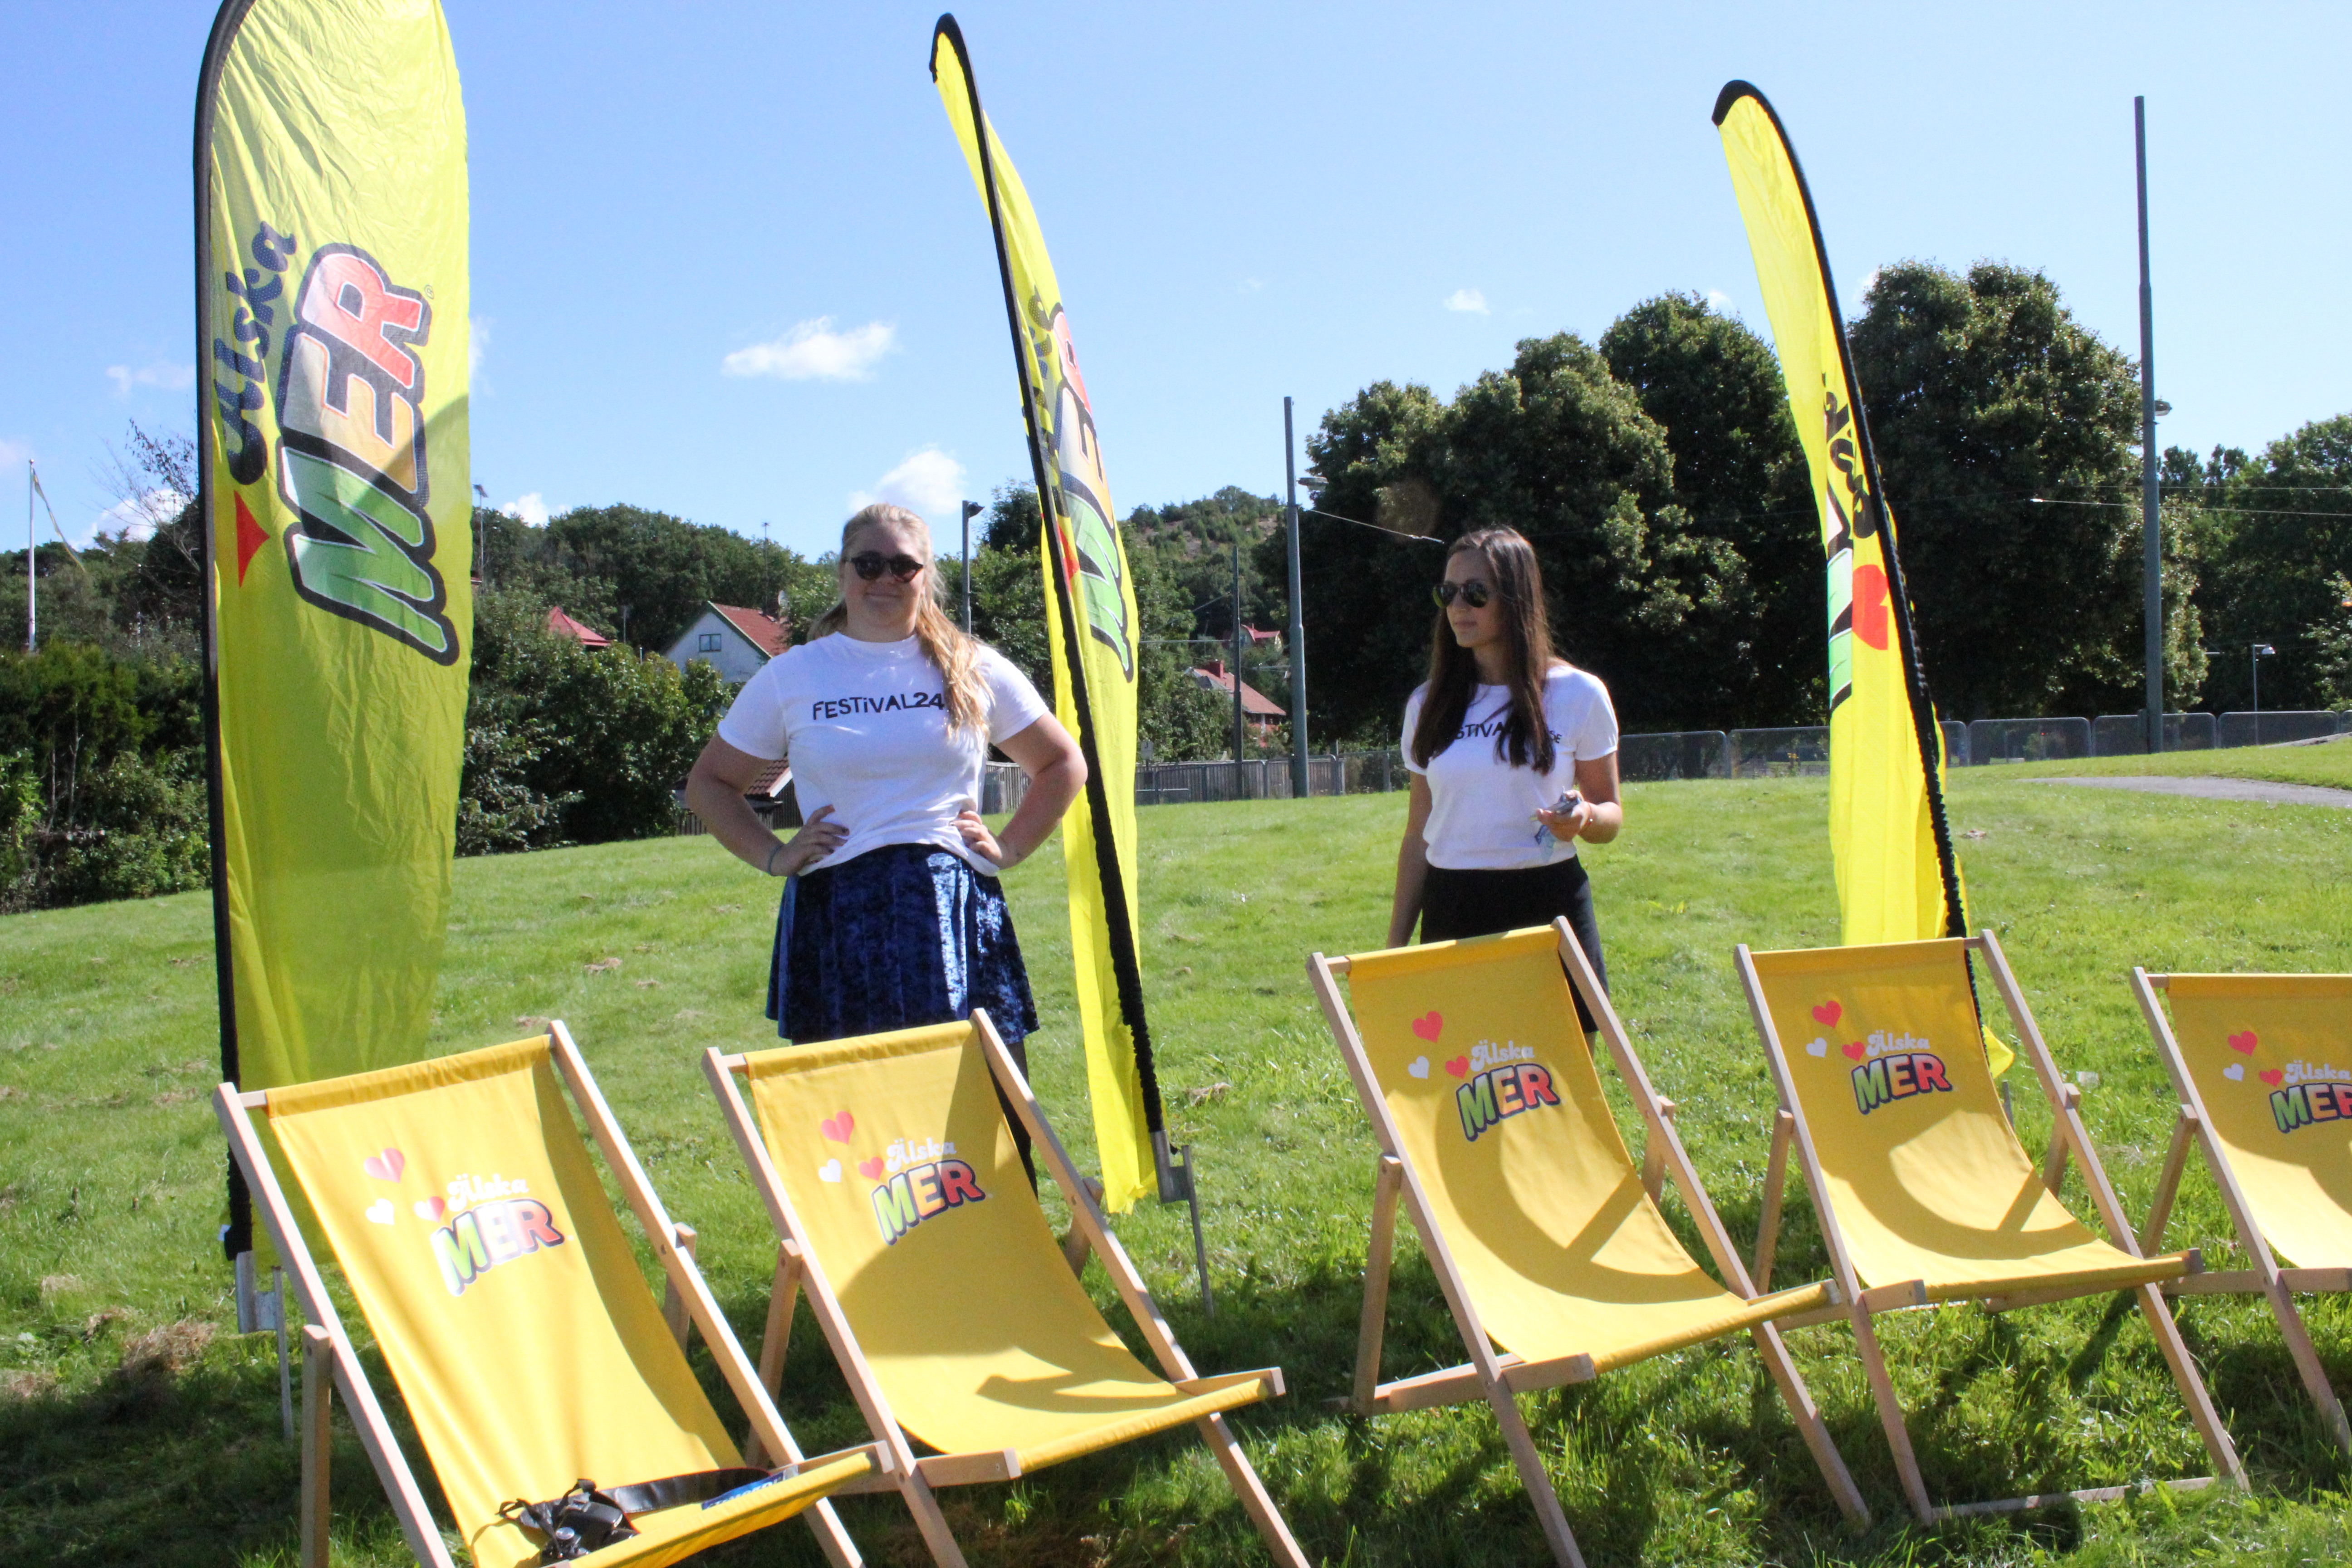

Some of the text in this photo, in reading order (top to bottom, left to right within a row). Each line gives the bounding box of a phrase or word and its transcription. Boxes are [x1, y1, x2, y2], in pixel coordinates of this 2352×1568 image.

[275, 243, 459, 666] MER
[1470, 1039, 1535, 1072] Älska
[1866, 1029, 1930, 1057] Älska
[1851, 1053, 1953, 1115] MER
[2284, 1059, 2352, 1083] Älska
[1456, 1063, 1561, 1142] MER
[886, 1137, 957, 1172] Älska
[447, 1173, 529, 1212] Älska
[871, 1159, 986, 1246] MER
[430, 1197, 565, 1297] MER
